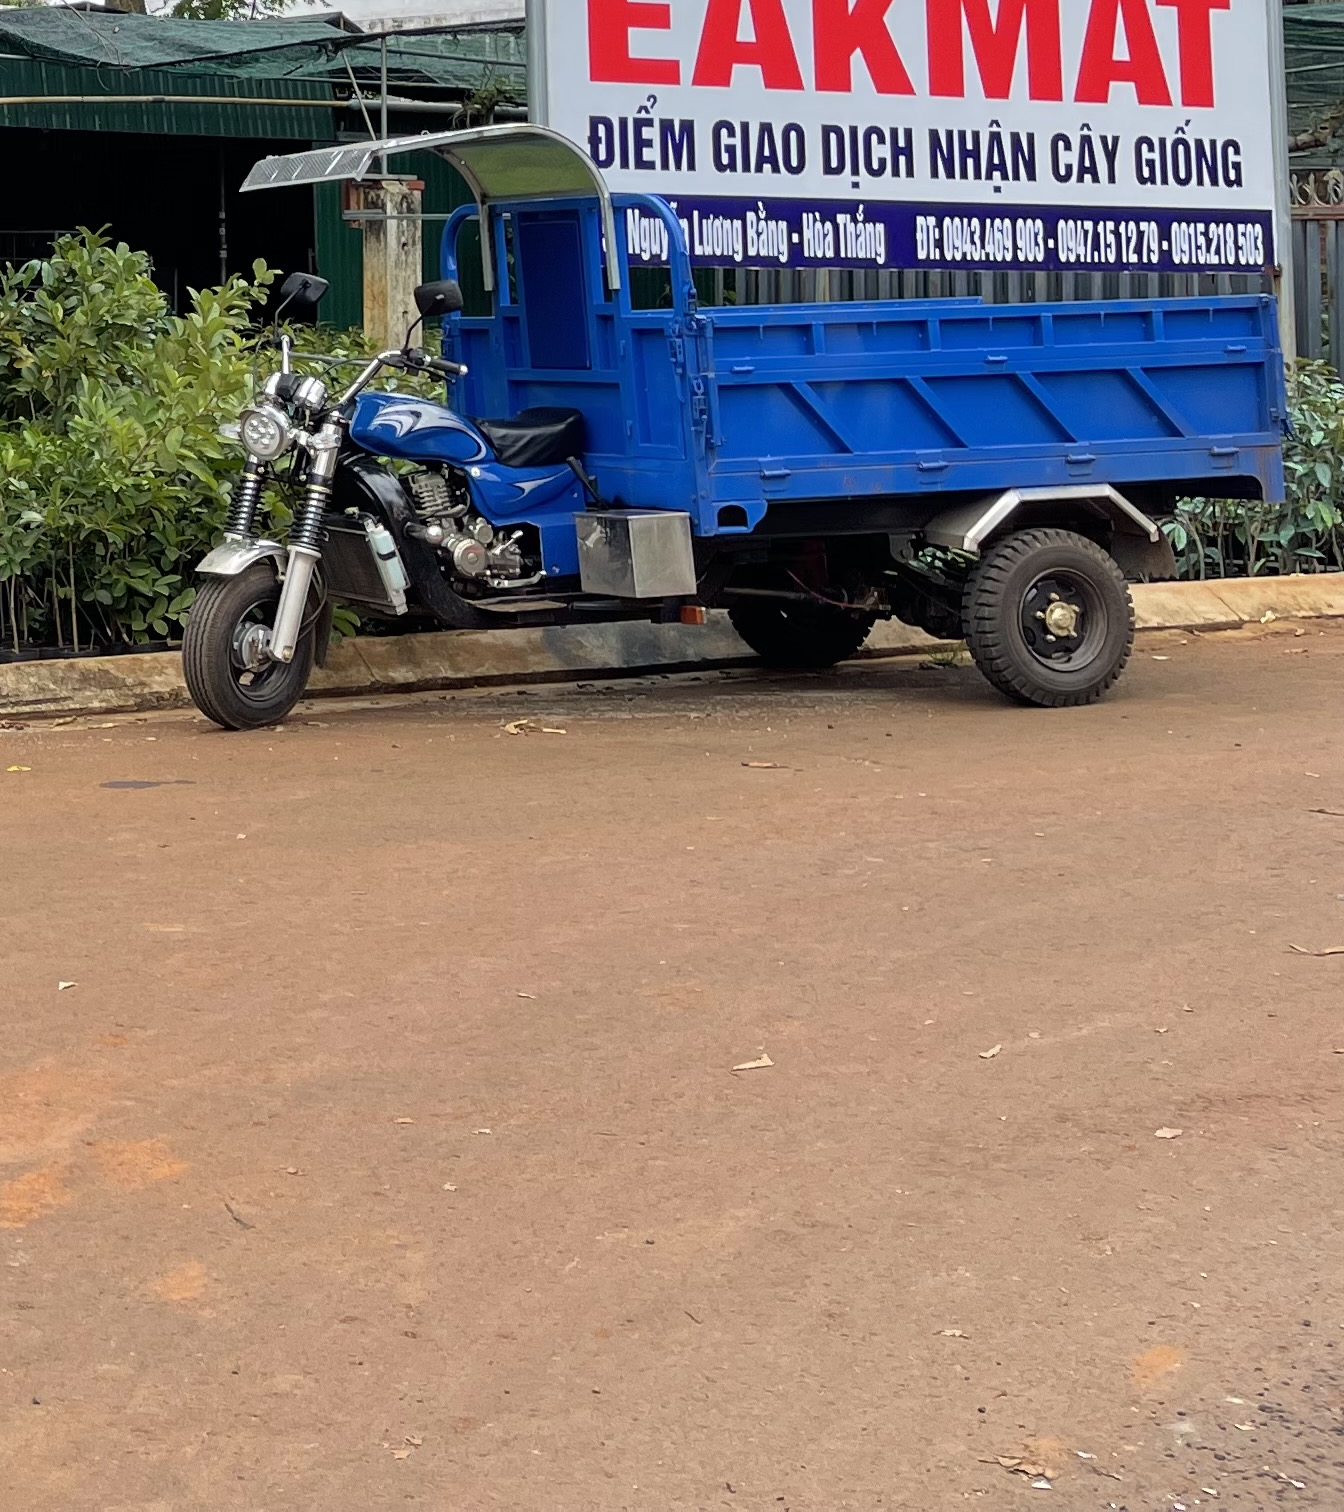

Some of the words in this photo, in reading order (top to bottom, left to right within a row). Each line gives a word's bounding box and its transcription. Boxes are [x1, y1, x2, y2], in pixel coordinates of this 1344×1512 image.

[588, 95, 696, 171] ĐIỂM
[712, 120, 805, 174] GIAO
[822, 125, 914, 188] DỊCH
[929, 120, 1036, 193] NHẬN
[1051, 124, 1120, 184] CÂY
[1135, 120, 1242, 187] GIỐNG
[627, 202, 689, 261] Nguyn
[693, 211, 742, 261] Lương
[747, 202, 787, 262] Bằng
[792, 233, 799, 243] -
[803, 212, 834, 258] Hòa
[837, 204, 885, 264] Thắng
[917, 216, 939, 259] ĐT:
[1016, 219, 1044, 262] 903
[1048, 239, 1054, 248] -
[1058, 220, 1115, 263] 0947.15
[1119, 221, 1138, 263] 12
[1140, 222, 1158, 263] 79
[1162, 241, 1168, 250] -
[1172, 222, 1235, 264] 0915.218
[1238, 224, 1263, 265] 503
